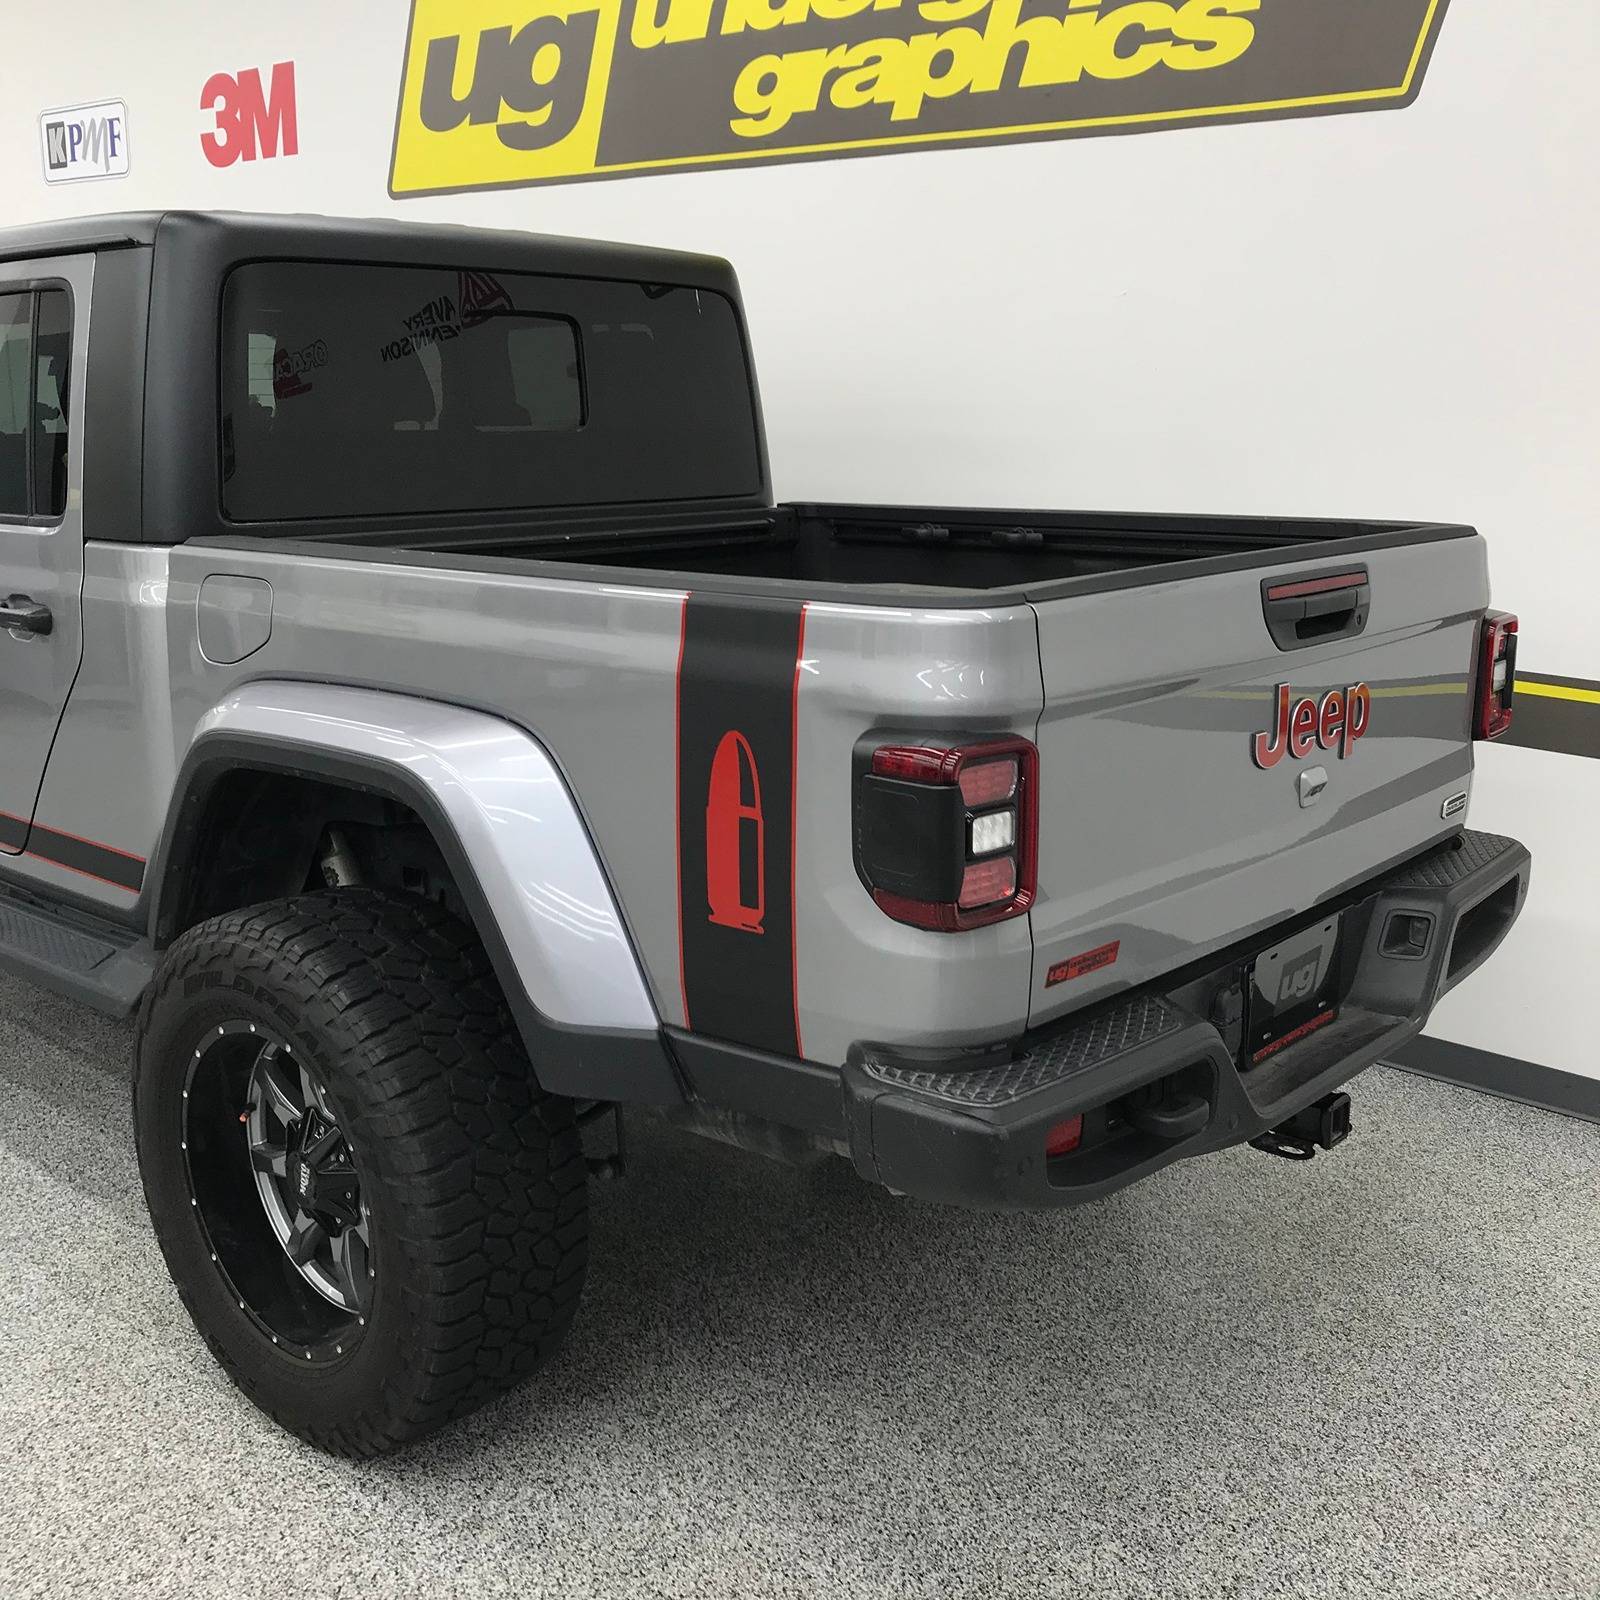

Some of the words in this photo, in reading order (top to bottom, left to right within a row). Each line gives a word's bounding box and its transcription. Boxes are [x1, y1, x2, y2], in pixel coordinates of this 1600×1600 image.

[200, 61, 298, 168] 3M
[419, 8, 600, 151] ug
[729, 0, 1258, 137] graphics
[46, 117, 121, 173] KPMF
[1250, 682, 1371, 769] Jeep
[1280, 960, 1319, 1001] ug
